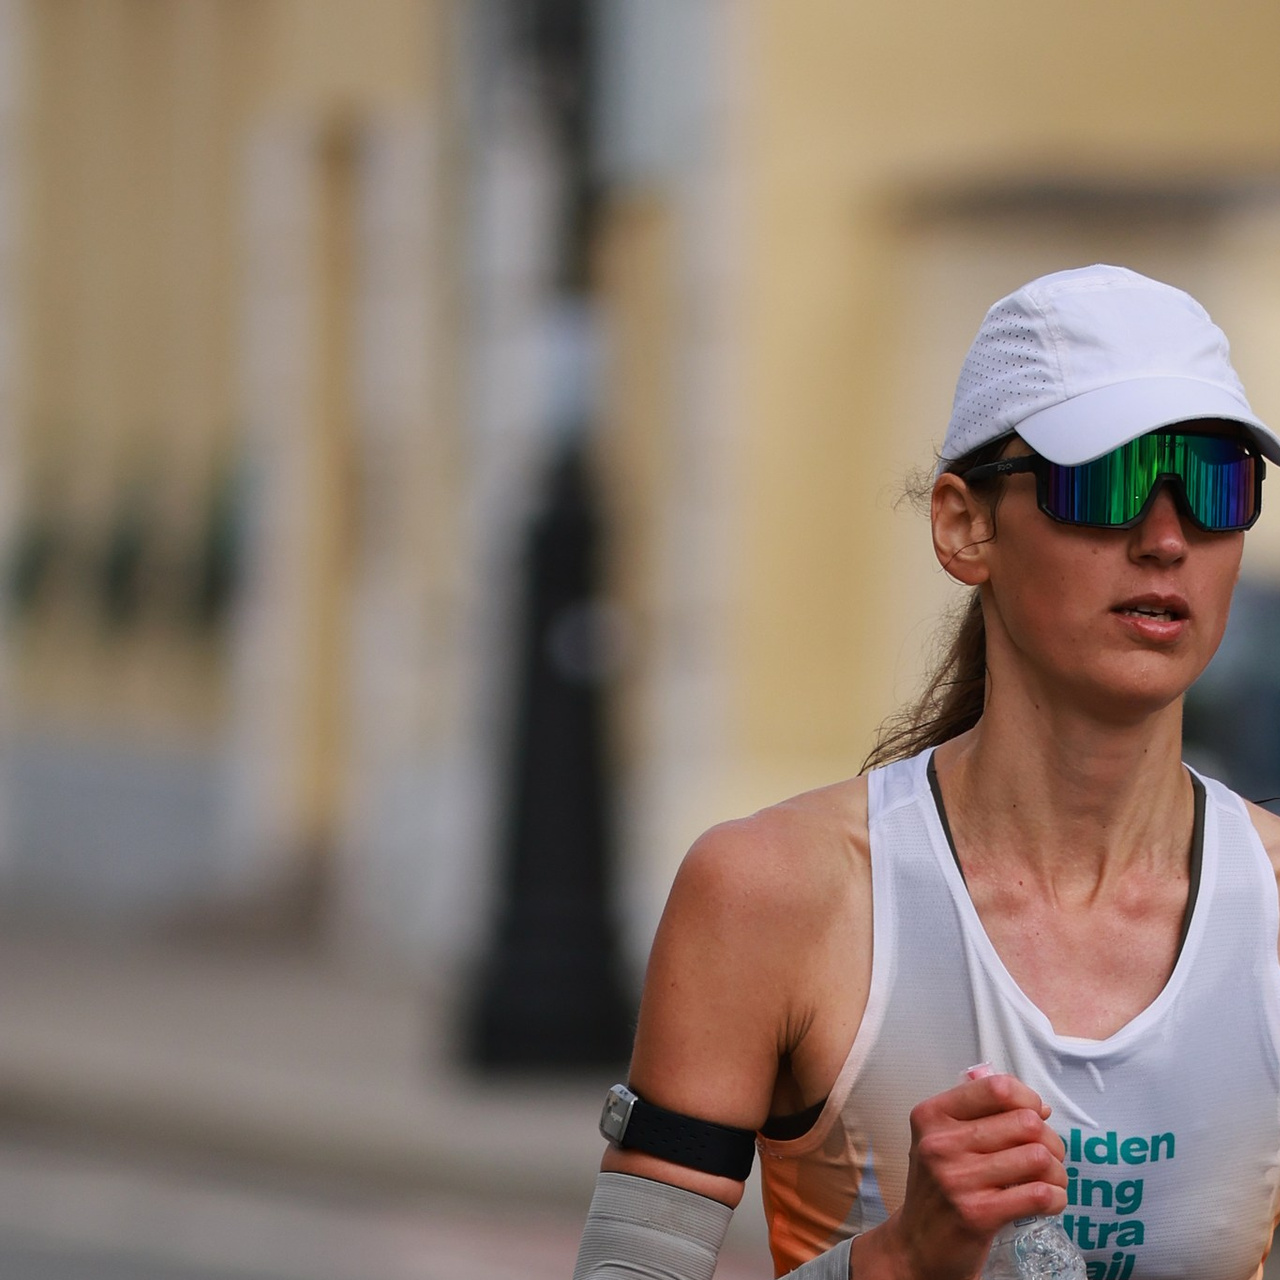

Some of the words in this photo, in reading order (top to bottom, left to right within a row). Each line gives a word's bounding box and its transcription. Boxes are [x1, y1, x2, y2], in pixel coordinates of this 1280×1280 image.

[1066, 1167, 1144, 1215] ing
[1063, 1215, 1144, 1250] ltra
[1085, 1252, 1136, 1280] ail
